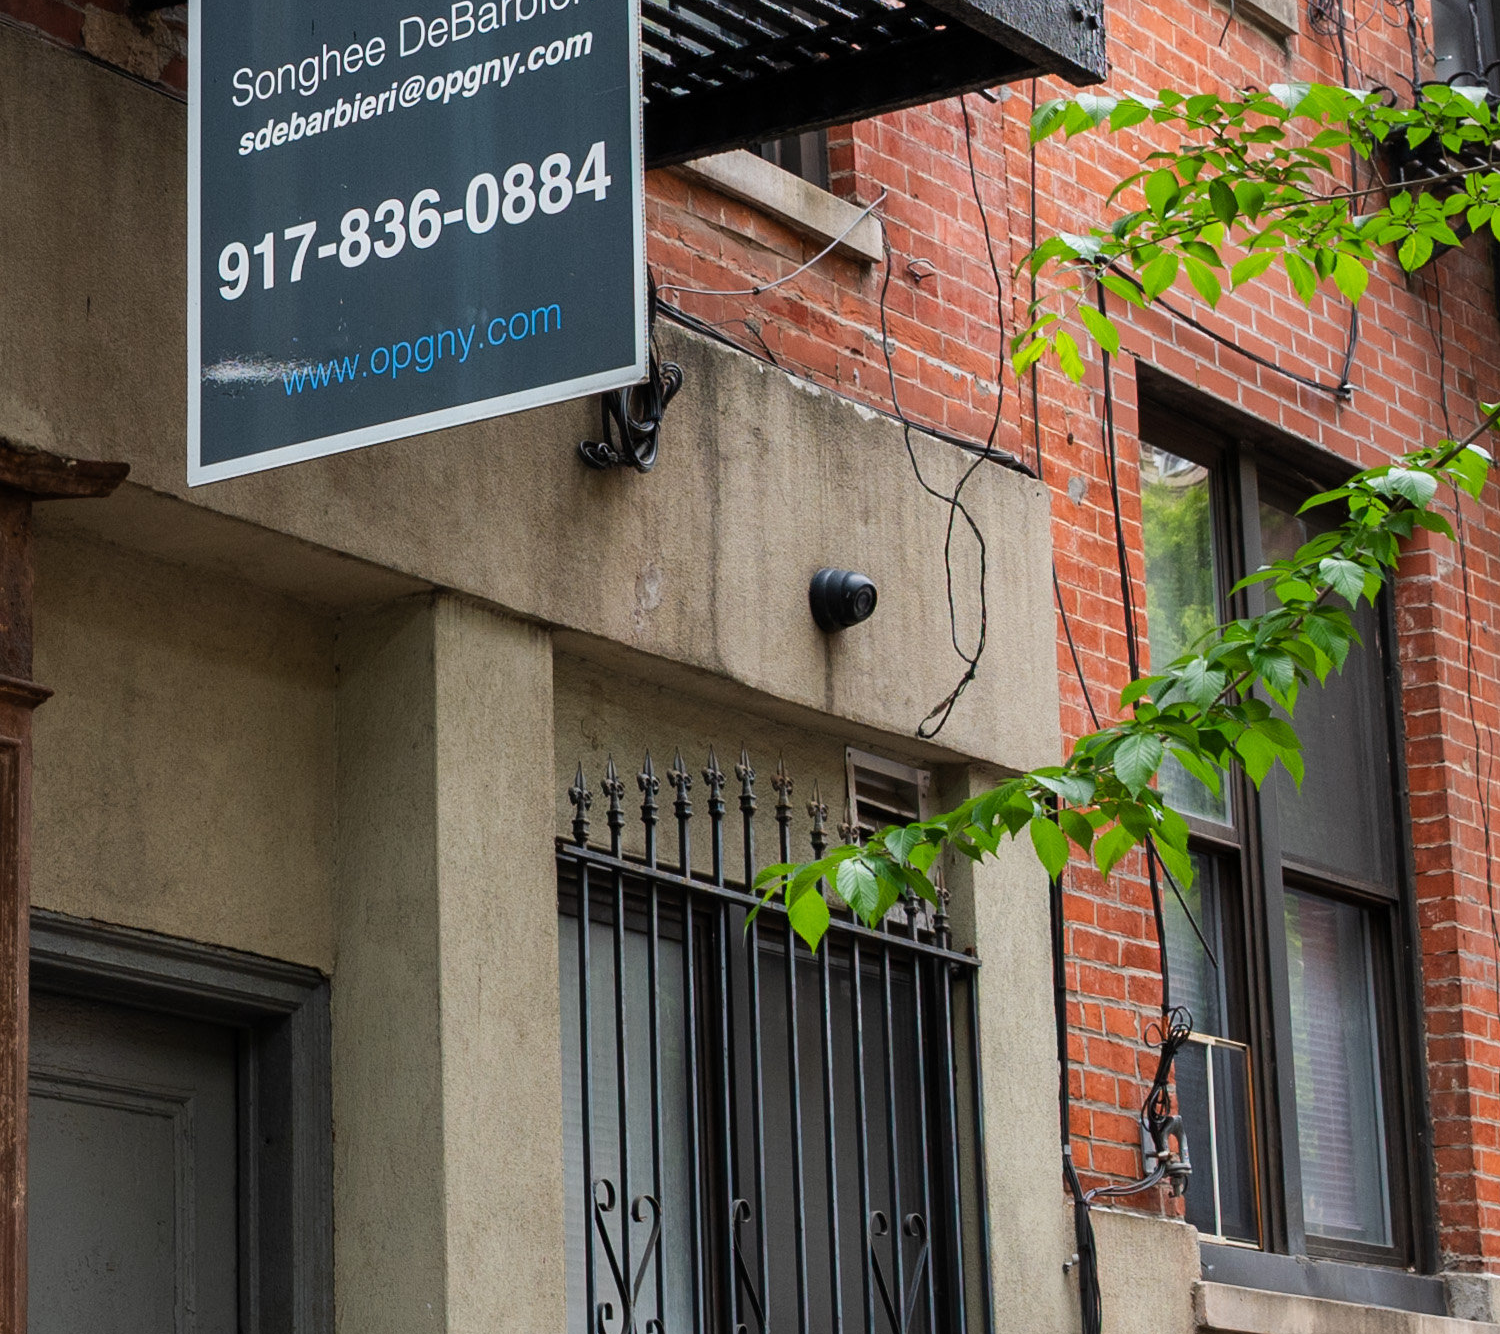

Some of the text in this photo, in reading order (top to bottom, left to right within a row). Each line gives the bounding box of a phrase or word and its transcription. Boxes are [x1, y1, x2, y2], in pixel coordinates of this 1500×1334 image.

[232, 33, 387, 107] Songhee
[238, 29, 593, 157] sdebarbieri@opgny.com
[217, 141, 612, 302] 917-836-0884
[282, 303, 562, 396] www.opgny.com
